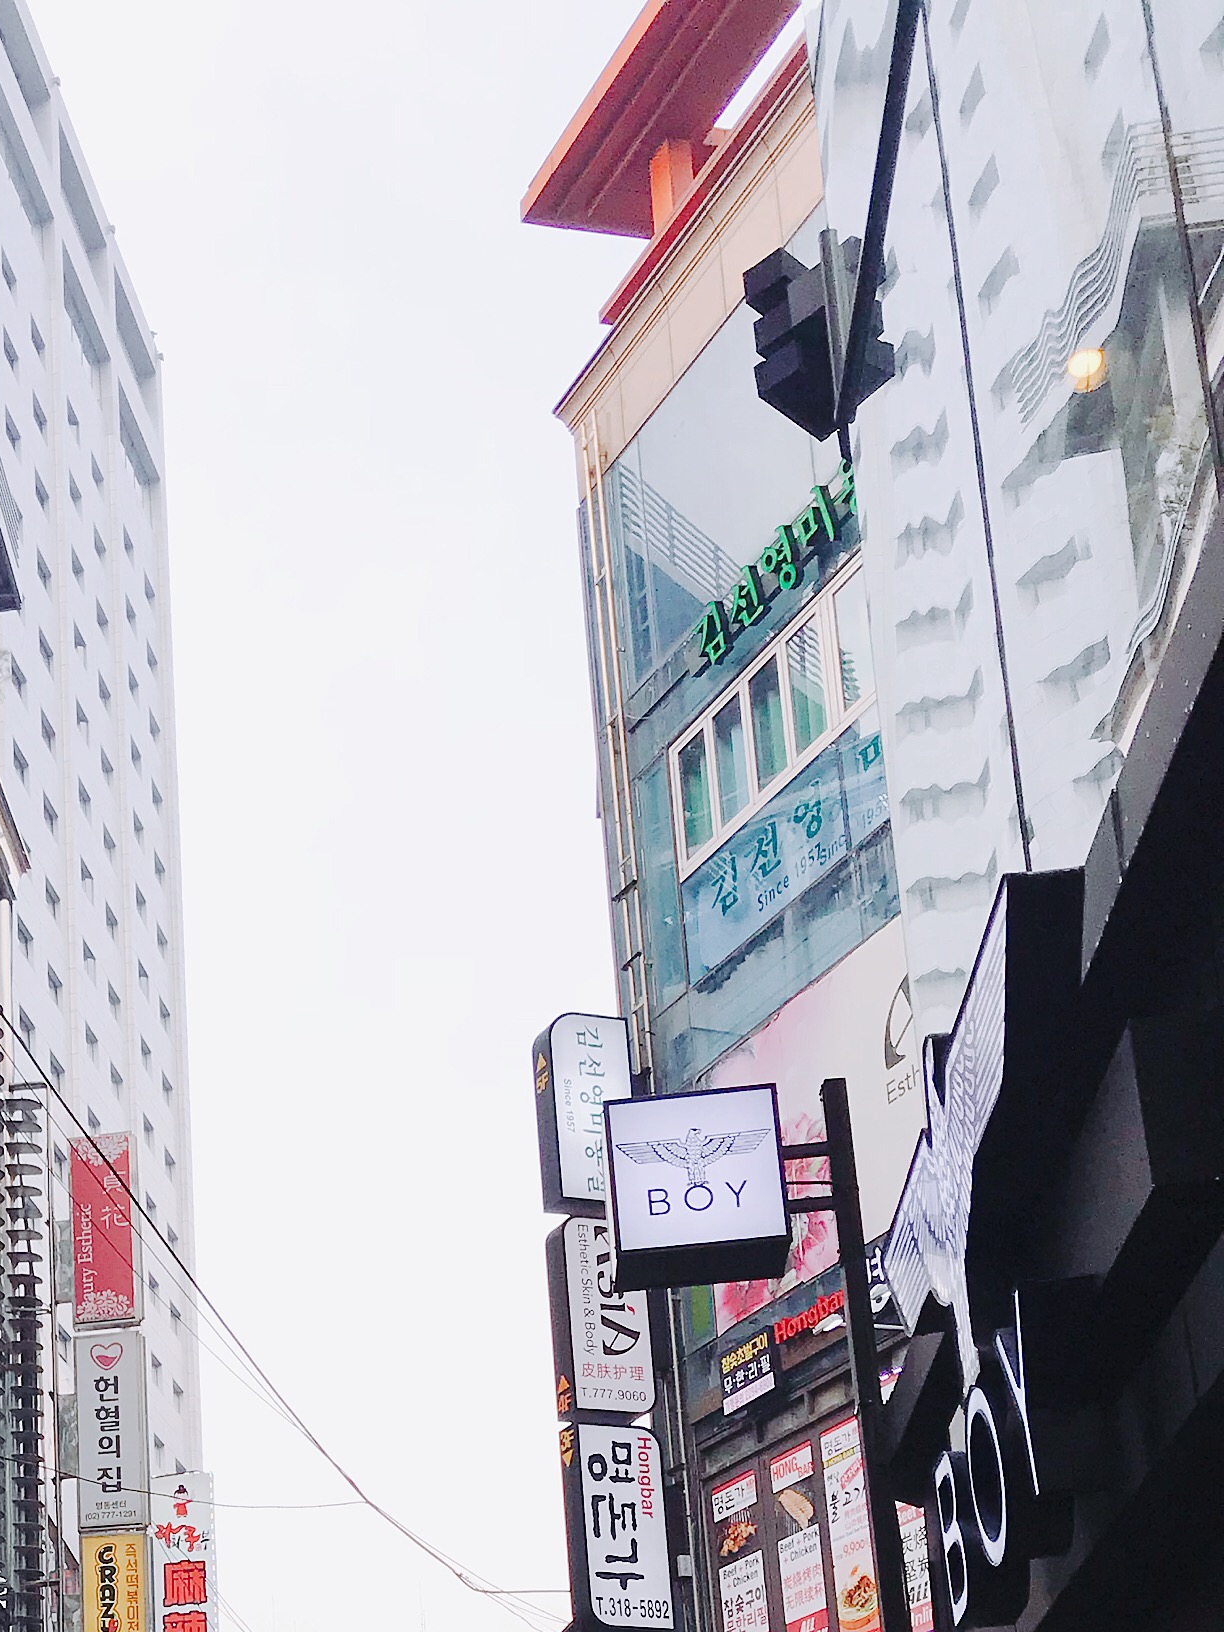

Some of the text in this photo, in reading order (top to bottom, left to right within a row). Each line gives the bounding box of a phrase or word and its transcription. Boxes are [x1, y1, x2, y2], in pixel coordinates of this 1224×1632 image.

[758, 874, 790, 913] Since
[535, 1074, 549, 1094] 5F
[563, 1078, 575, 1133] Since 1957
[647, 1180, 748, 1217] BOY
[77, 1203, 93, 1264] Esthetic
[577, 1224, 598, 1356] Esthetic Skin Body
[581, 1362, 645, 1381] 皮肤护理
[558, 1399, 571, 1413] 4F
[580, 1386, 647, 1402] T.777.9060
[94, 1376, 123, 1493] 헌혈의집
[560, 1433, 576, 1453] 3F
[771, 1457, 798, 1482] HONG
[934, 1290, 1040, 1627] BOY
[637, 1437, 656, 1519] Hongbar
[95, 1501, 127, 1510] 명동센터
[714, 1484, 746, 1514] 명돈가
[588, 1441, 646, 1591] 명돈가
[790, 1542, 818, 1562] Chicken
[733, 1569, 759, 1588] Chicken
[595, 1597, 670, 1619] T.318-5892
